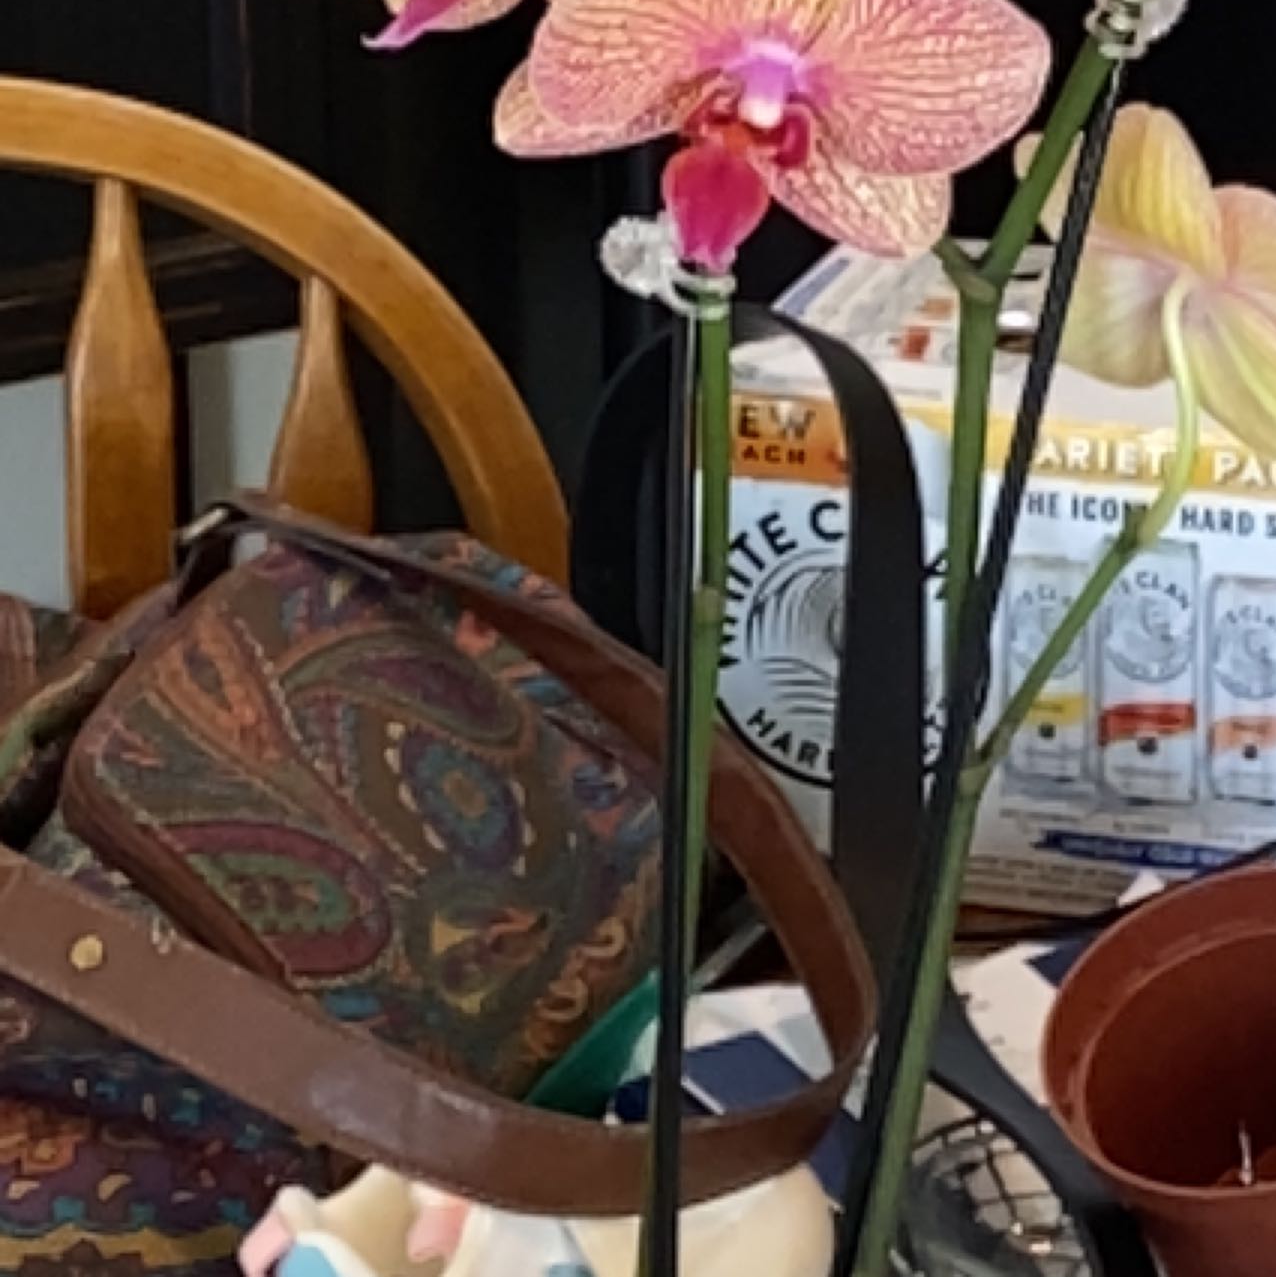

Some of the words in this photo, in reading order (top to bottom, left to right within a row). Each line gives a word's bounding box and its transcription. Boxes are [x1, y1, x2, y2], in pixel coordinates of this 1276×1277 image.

[738, 404, 816, 440] EW
[741, 444, 806, 465] ACH
[1033, 436, 1177, 477] ARIET
[1027, 491, 1060, 519] HE
[1180, 504, 1255, 537] HARD
[746, 707, 838, 772] HAR
